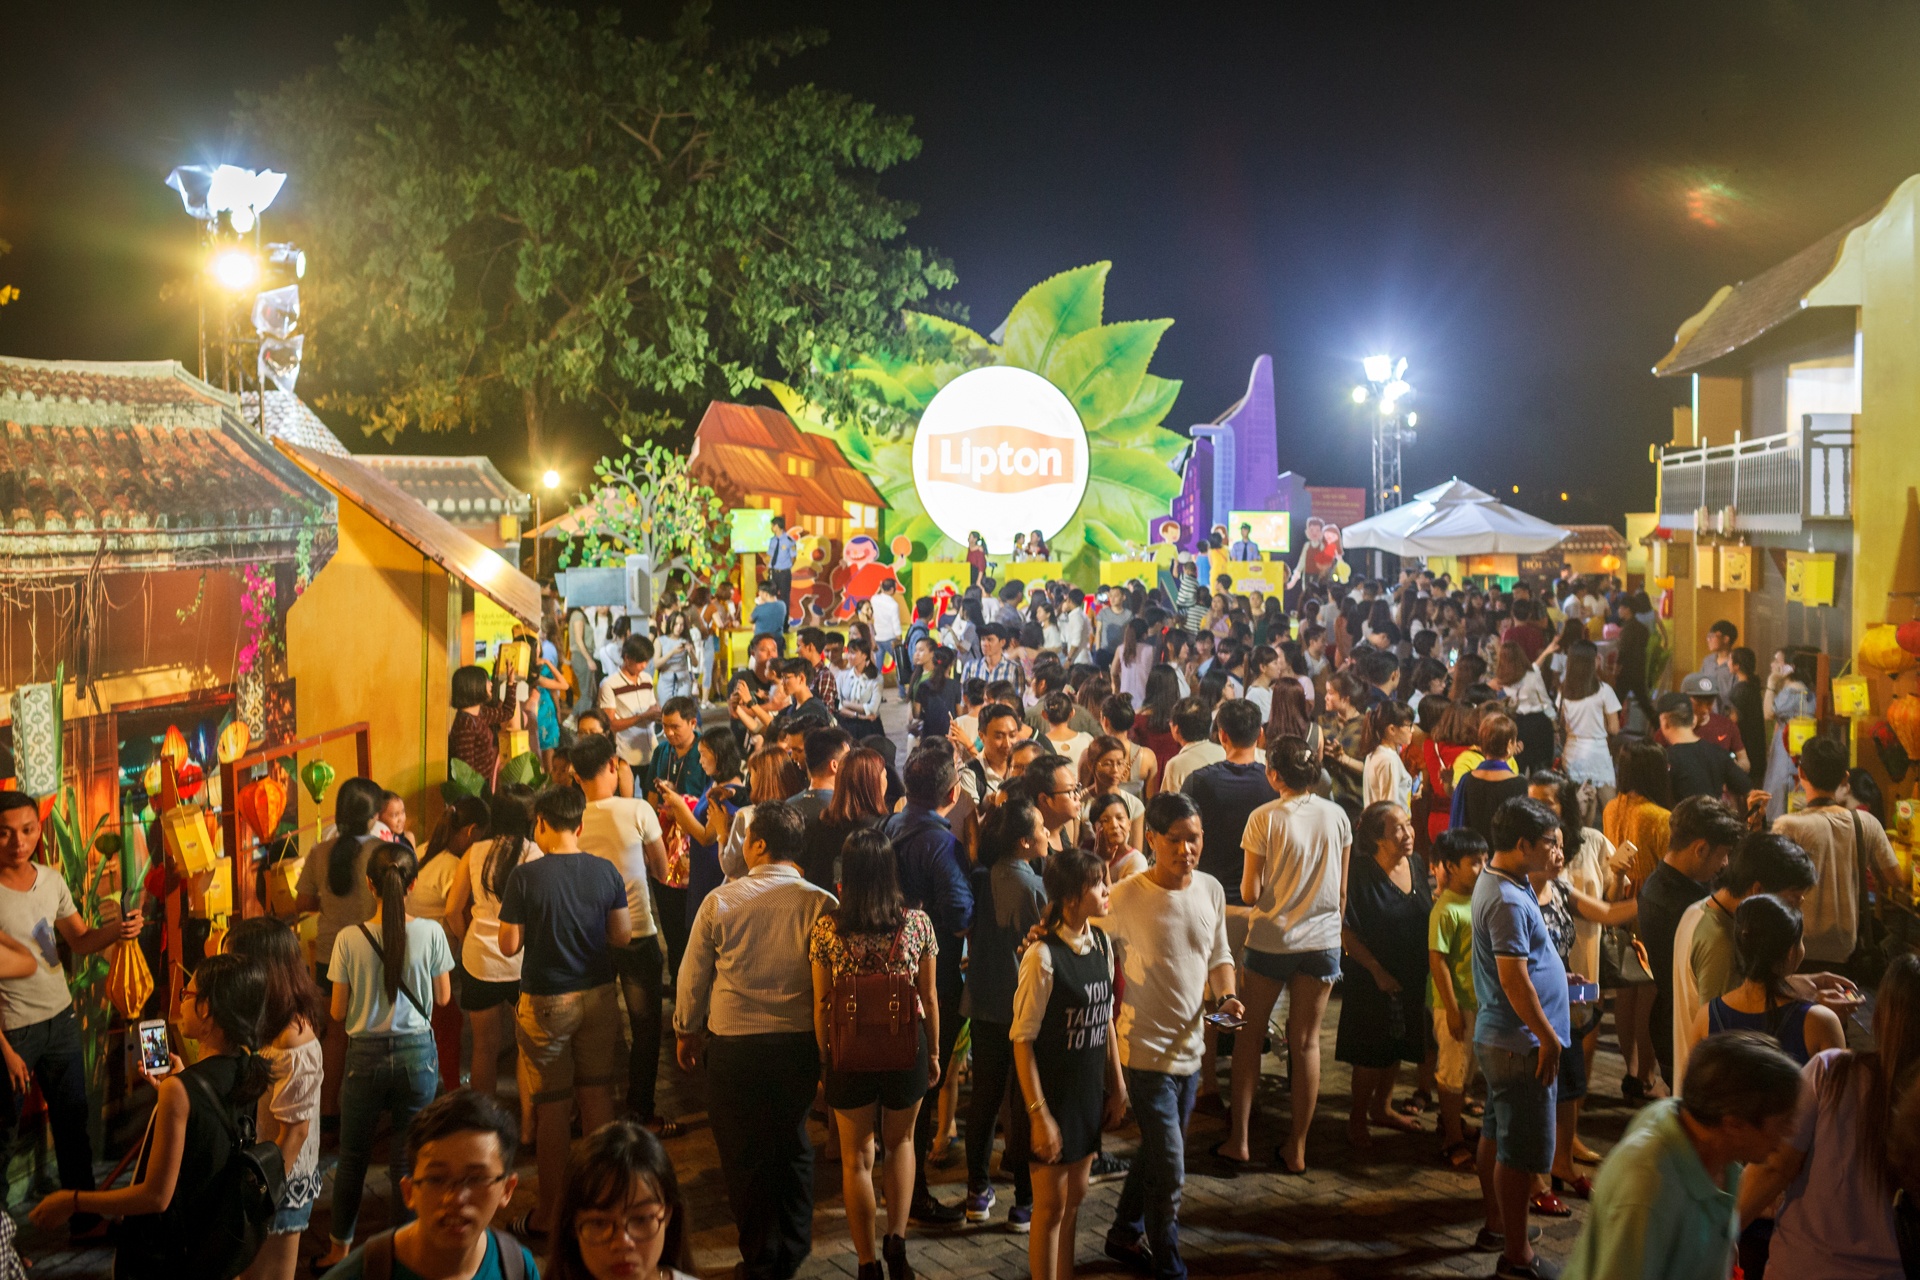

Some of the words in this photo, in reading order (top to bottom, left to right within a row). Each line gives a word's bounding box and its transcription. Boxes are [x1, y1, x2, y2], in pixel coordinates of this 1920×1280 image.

[940, 437, 1063, 483] Lipton
[1084, 980, 1108, 1005] YOU
[1065, 1002, 1111, 1029] TALKIN
[1067, 1028, 1085, 1050] TO
